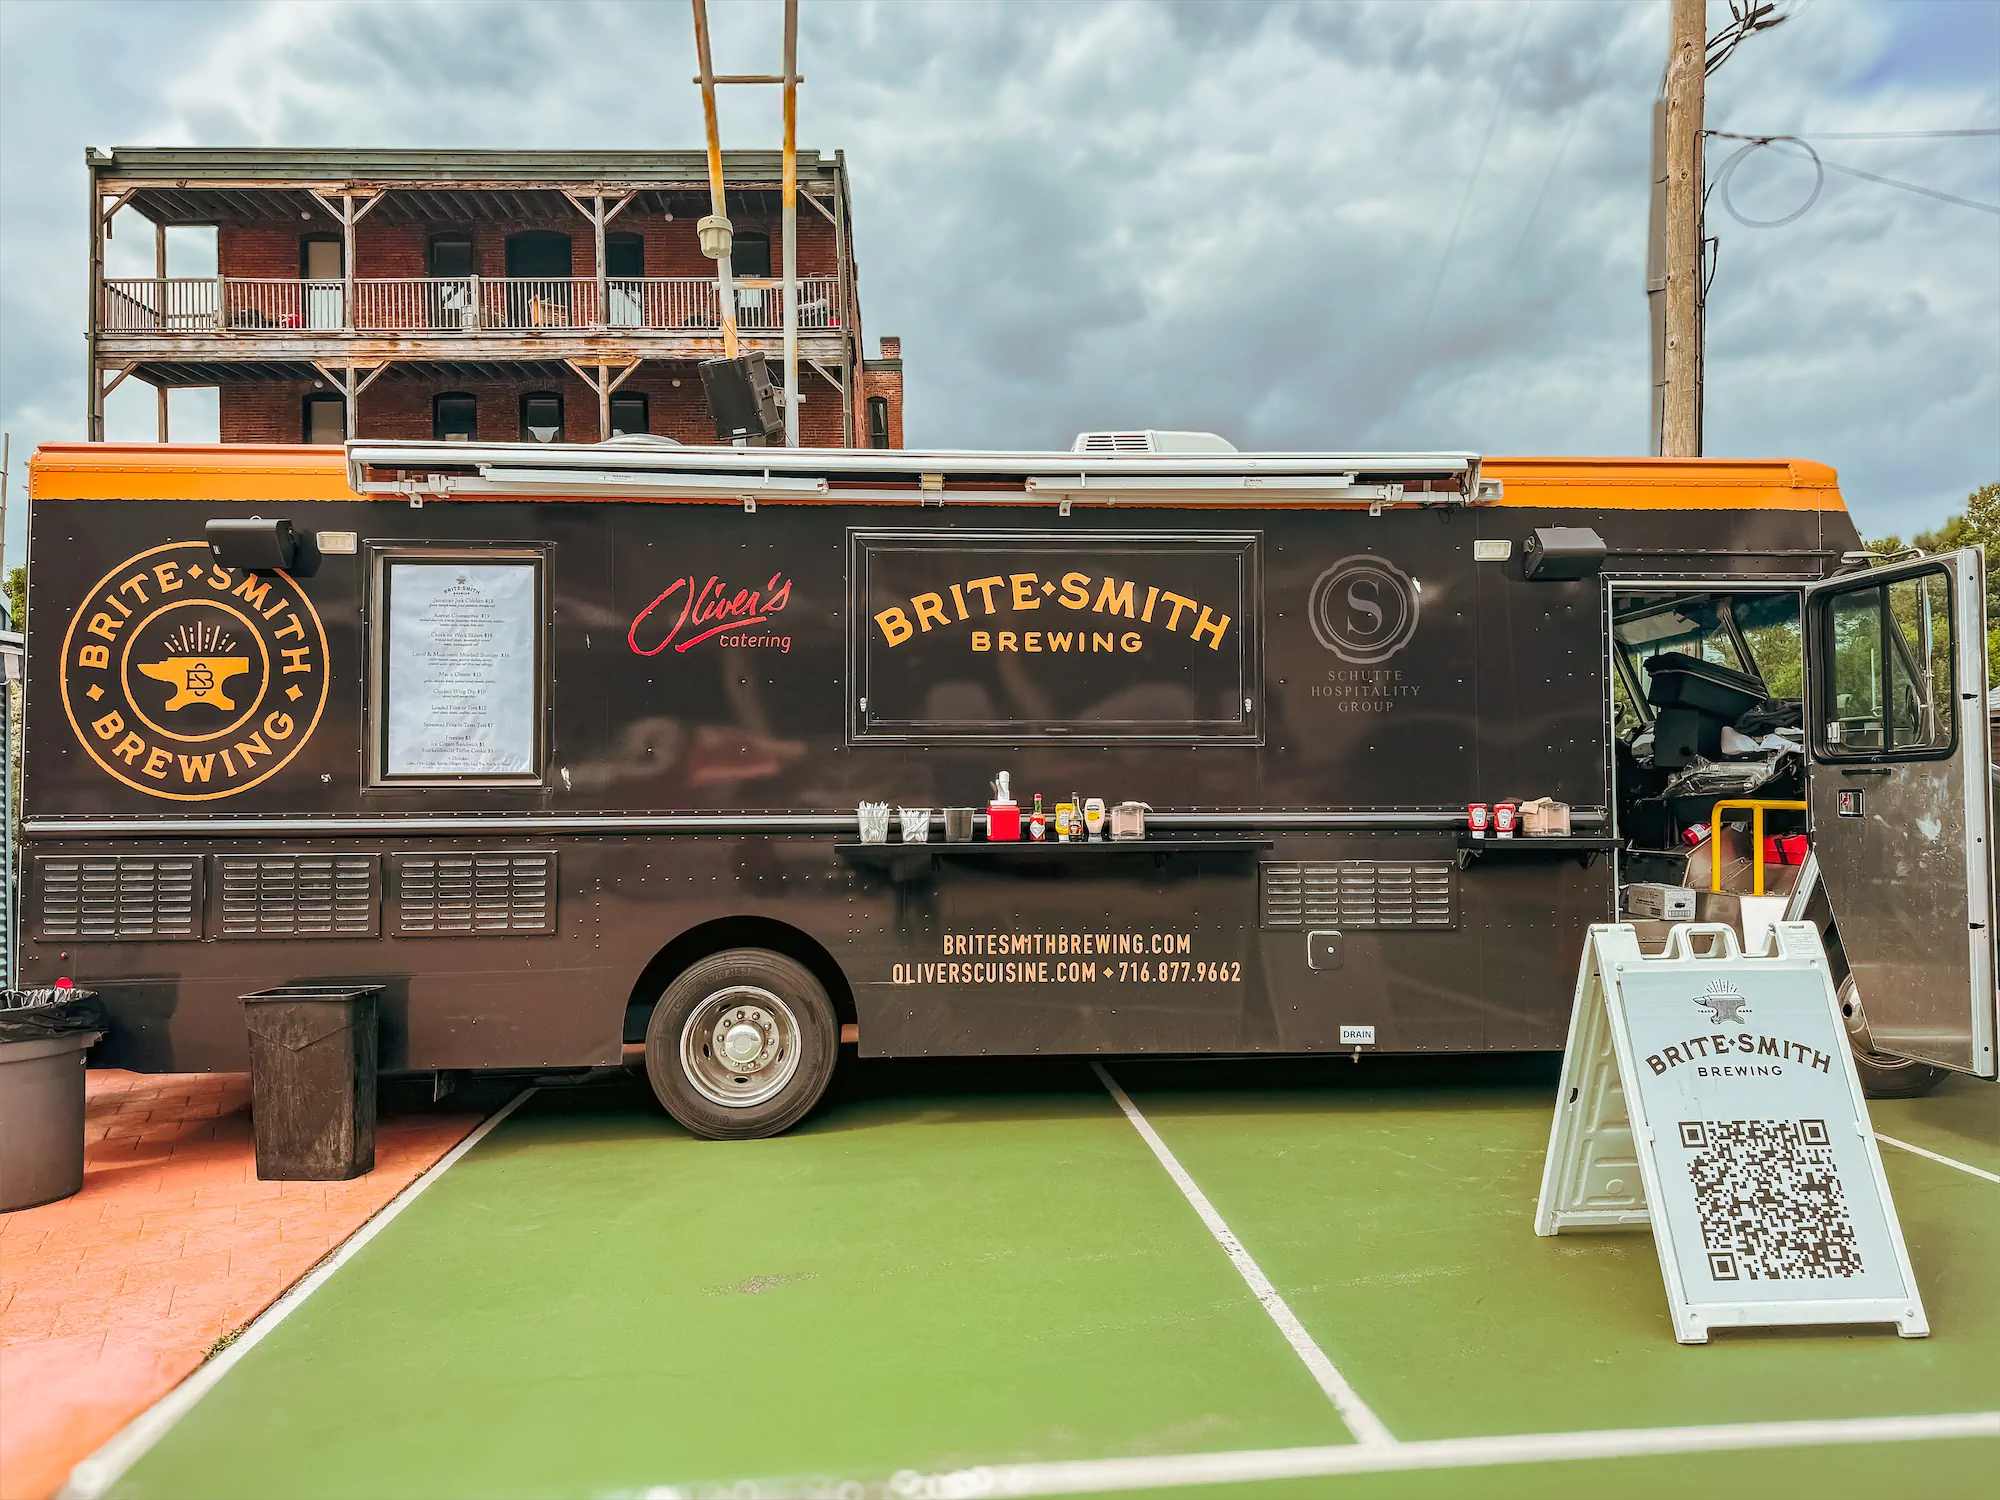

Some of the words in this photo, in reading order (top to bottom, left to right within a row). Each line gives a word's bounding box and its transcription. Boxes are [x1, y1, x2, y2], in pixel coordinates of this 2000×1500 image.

[78, 561, 183, 670] BRITE
[207, 563, 311, 674] SMITH
[628, 572, 792, 656] Oliver's
[873, 573, 1041, 648] BRITE
[1057, 572, 1232, 651] SMITH
[1346, 579, 1383, 635] S
[719, 634, 791, 653] catering
[971, 631, 1143, 653] BREWING
[1328, 670, 1403, 681] SCHUTTE
[1311, 686, 1421, 697] HOSPITALITY
[1338, 701, 1394, 713] GROUP
[91, 709, 294, 783] BREWING
[942, 933, 1192, 955] BRITESMITHBREWING.COM
[892, 962, 1097, 984] OLIVERSCUISINE.COM
[1118, 962, 1242, 983] 716.877.9662
[1343, 1030, 1372, 1039] DRAIN
[1645, 1034, 1730, 1076] BRITE
[1737, 1033, 1832, 1074] SMITH
[1697, 1065, 1783, 1077] BREWING
